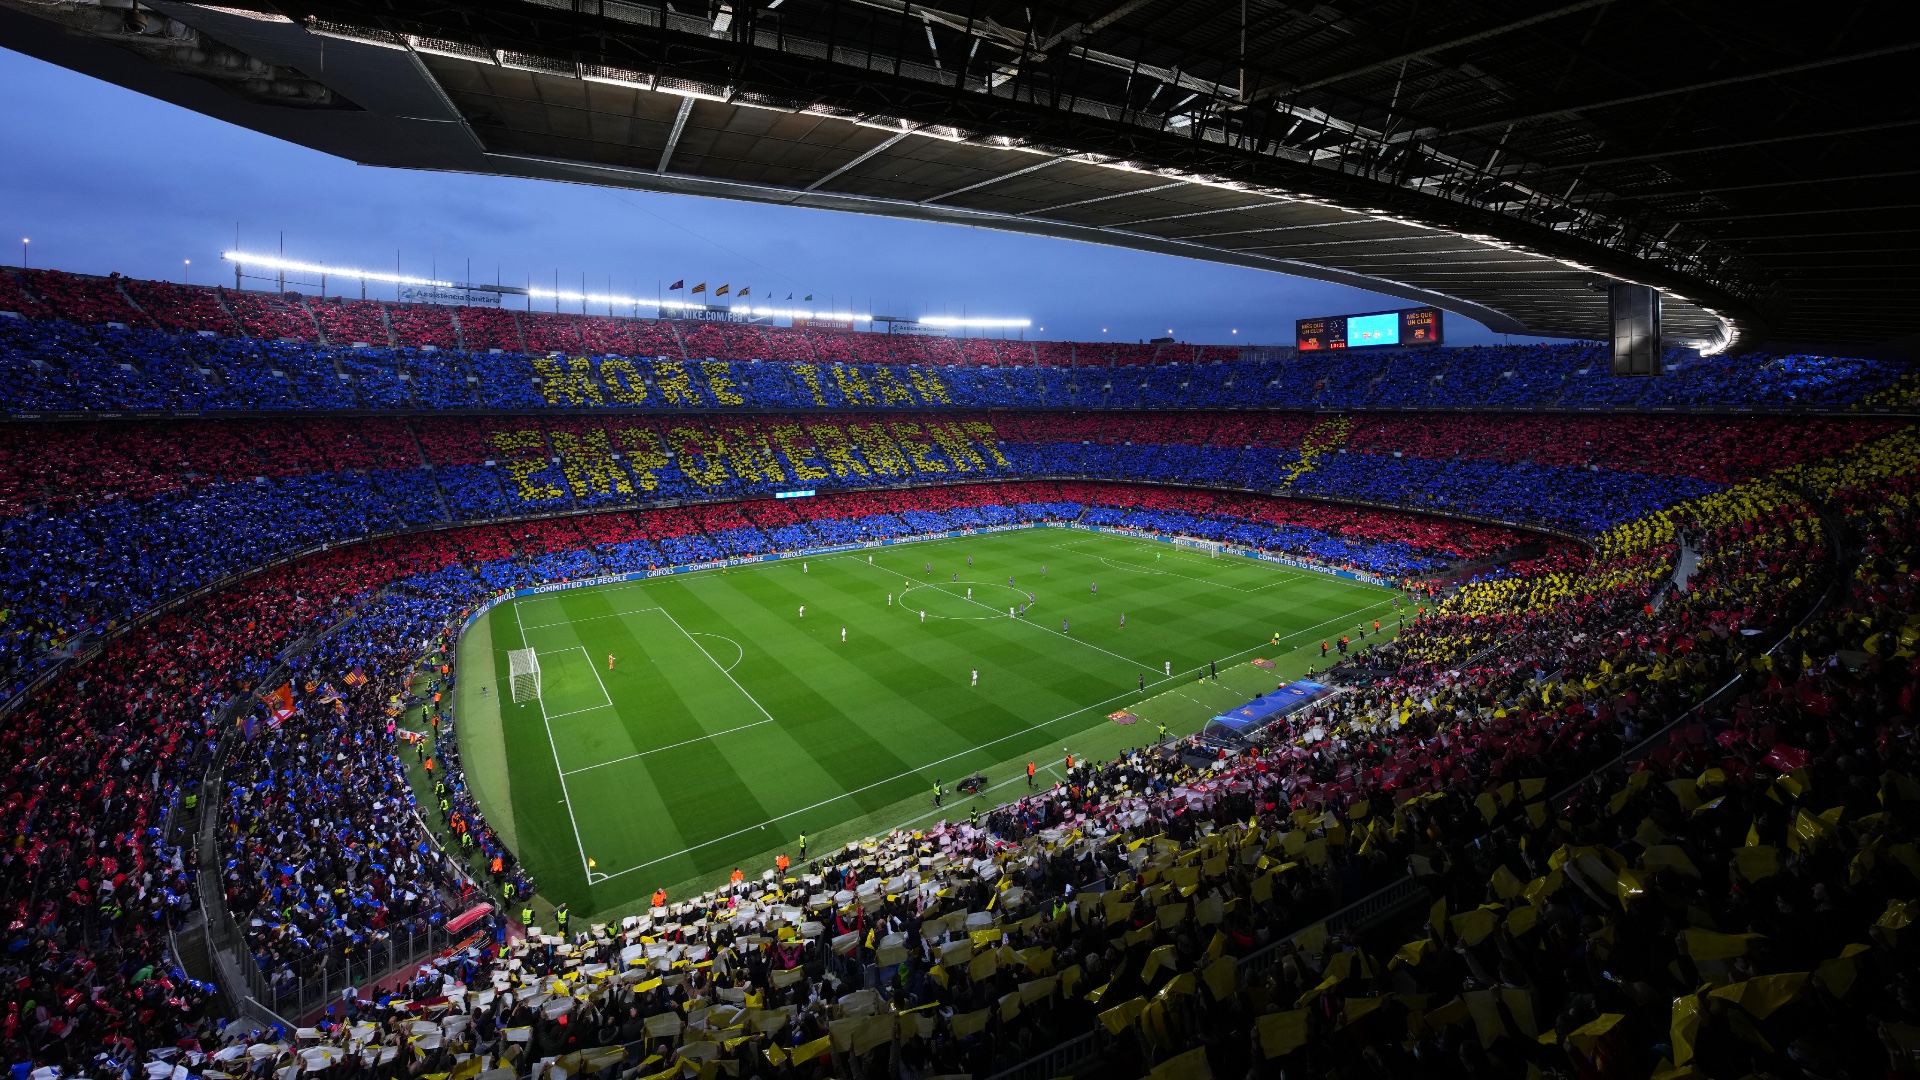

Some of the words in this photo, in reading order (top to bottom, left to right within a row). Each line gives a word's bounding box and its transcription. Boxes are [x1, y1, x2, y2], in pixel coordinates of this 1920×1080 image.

[683, 309, 743, 323] NIKE.COM/FCB
[530, 356, 744, 406] MORE
[793, 362, 952, 406] THAN
[490, 420, 1010, 500] EMPOWERMENT
[1099, 527, 1129, 536] COMMITTED
[779, 550, 803, 559] GRIFOLS
[1222, 546, 1246, 557] GRIFOLS
[688, 560, 728, 572] COMMITTED
[729, 558, 739, 566] TO
[740, 555, 764, 564] PEOPLE
[1258, 554, 1296, 567] COMMITTED
[1298, 561, 1308, 569] TO
[1309, 563, 1337, 576] PEOPLE
[646, 568, 674, 578] GRIFOLS
[1355, 574, 1385, 586] GRIFOLS
[533, 581, 582, 594] COMMITTED
[584, 578, 595, 586] TO
[597, 574, 627, 585] PEOPLE
